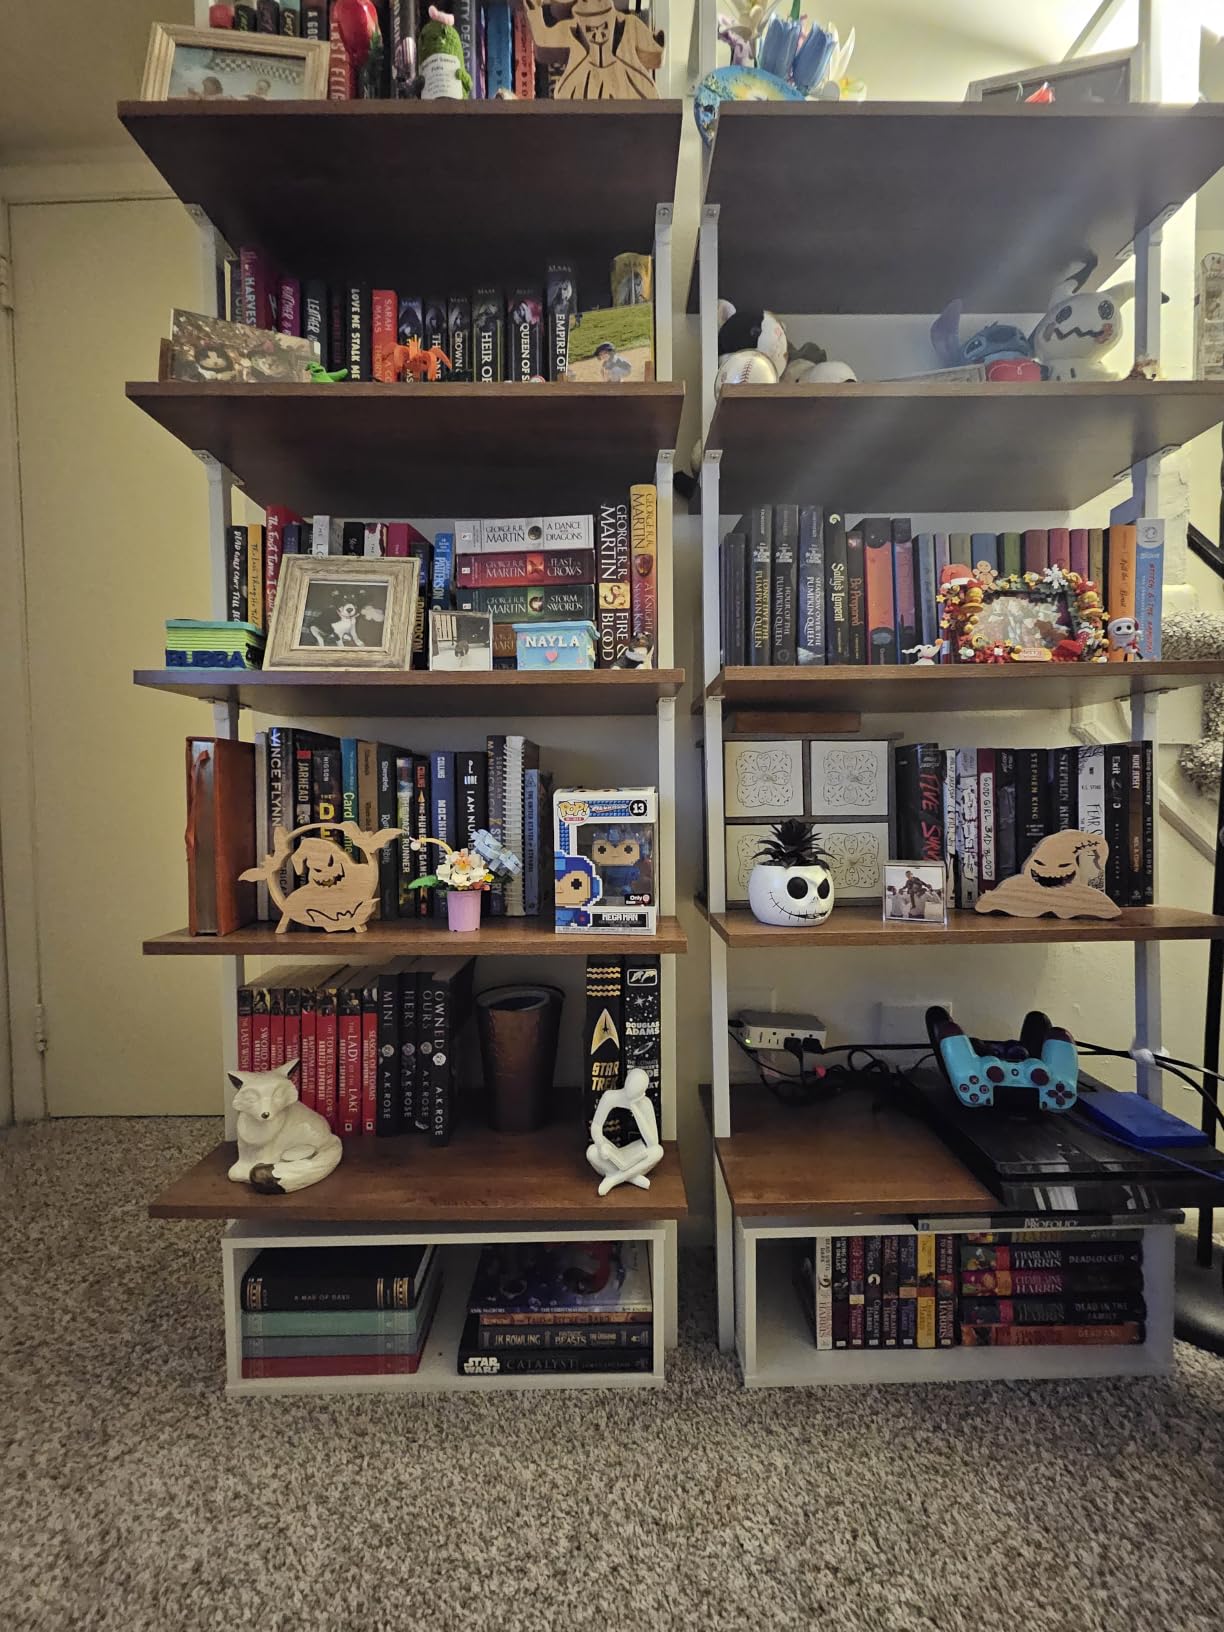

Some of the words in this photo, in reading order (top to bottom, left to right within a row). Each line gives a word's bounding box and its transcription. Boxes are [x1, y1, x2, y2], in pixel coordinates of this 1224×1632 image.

[351, 288, 361, 313] LOVE
[351, 315, 361, 329] ME
[375, 305, 383, 333] MAAS
[384, 298, 393, 331] SARAH
[481, 331, 492, 362] HEIR
[520, 323, 530, 357] QUEEN
[556, 313, 566, 354] EMPIRE
[351, 333, 361, 361] STALK
[455, 331, 463, 366] CROWN
[351, 365, 361, 380] ME
[520, 360, 530, 374] OF
[556, 356, 566, 372] OF
[547, 522, 553, 530] A
[554, 521, 581, 529] DANCE
[616, 504, 628, 552] GEORGE
[632, 493, 645, 549] MARTIN
[486, 532, 525, 543] MARTIN
[545, 533, 583, 542] DRAGONS
[600, 504, 616, 579] MARTIN
[486, 567, 526, 577] MARTIN
[547, 566, 583, 576] CROWS
[616, 556, 628, 567] R.
[616, 569, 628, 580] R.
[433, 557, 444, 600] PATTERSON
[550, 594, 578, 602] STORM
[633, 583, 641, 611] SEVEN
[775, 576, 783, 614] PUMPKIN
[783, 586, 791, 610] HOUR
[806, 577, 814, 616] PUMPKIN
[814, 577, 822, 608] SHADOW
[487, 604, 526, 614] MARTIN
[546, 602, 583, 612] SWORDS
[644, 594, 653, 629] KNIGHT
[814, 610, 822, 630] OVER
[831, 592, 845, 622] Lament
[601, 612, 614, 661] BLOOD
[616, 612, 628, 641] FIRE
[752, 615, 762, 648] QUEEN
[774, 617, 783, 646] QUEEN
[783, 621, 791, 635] THE
[804, 617, 814, 646] QUEEN
[814, 632, 822, 646] THE
[525, 635, 580, 648] NAYLA
[616, 643, 628, 660] &
[270, 731, 282, 778] VINCE
[437, 756, 446, 778] COLLINS
[1112, 755, 1121, 774] Exit
[1131, 754, 1140, 769] NUKE
[298, 761, 311, 802] JARHEAD
[322, 756, 330, 782] HIGSON
[1030, 753, 1038, 793] STEPHEN
[1059, 754, 1069, 800] STEPHEN
[1131, 770, 1140, 790] JERSEY
[920, 772, 940, 811] FIVE
[983, 777, 992, 797] GOOD
[271, 782, 281, 827] FLYNN
[343, 792, 355, 818] Card
[466, 794, 475, 812] AM
[560, 801, 589, 817] POP!
[632, 803, 644, 814] 13
[1030, 797, 1038, 820] KING
[1086, 804, 1102, 827] FEAR
[984, 825, 992, 844] BAD
[402, 838, 411, 873] RUNNER
[984, 848, 992, 876] BLOOD
[404, 990, 415, 1028] HERS
[422, 990, 432, 1029] OURS
[434, 990, 445, 1049] OWNED
[241, 1028, 249, 1046] LAST
[260, 1027, 268, 1060] SWORD
[326, 1036, 334, 1064] TOWER
[348, 1035, 358, 1063] LADY
[368, 1030, 376, 1058] SEASON
[241, 1048, 249, 1068] WISH
[592, 1060, 620, 1076] STAR
[326, 1074, 334, 1118] SWALLOWS
[368, 1071, 376, 1100] STORMS
[592, 1077, 618, 1091] TREK
[348, 1088, 358, 1113] LAKE
[404, 1092, 412, 1118] ROSE
[435, 1109, 443, 1136] ROSE
[1016, 1258, 1062, 1268] HARRIS
[1016, 1284, 1063, 1294] HARRIS
[939, 1300, 948, 1338] HARRIS
[506, 1334, 541, 1345] ROWLING
[464, 1364, 500, 1374] WARS
[468, 1356, 499, 1366] STAR
